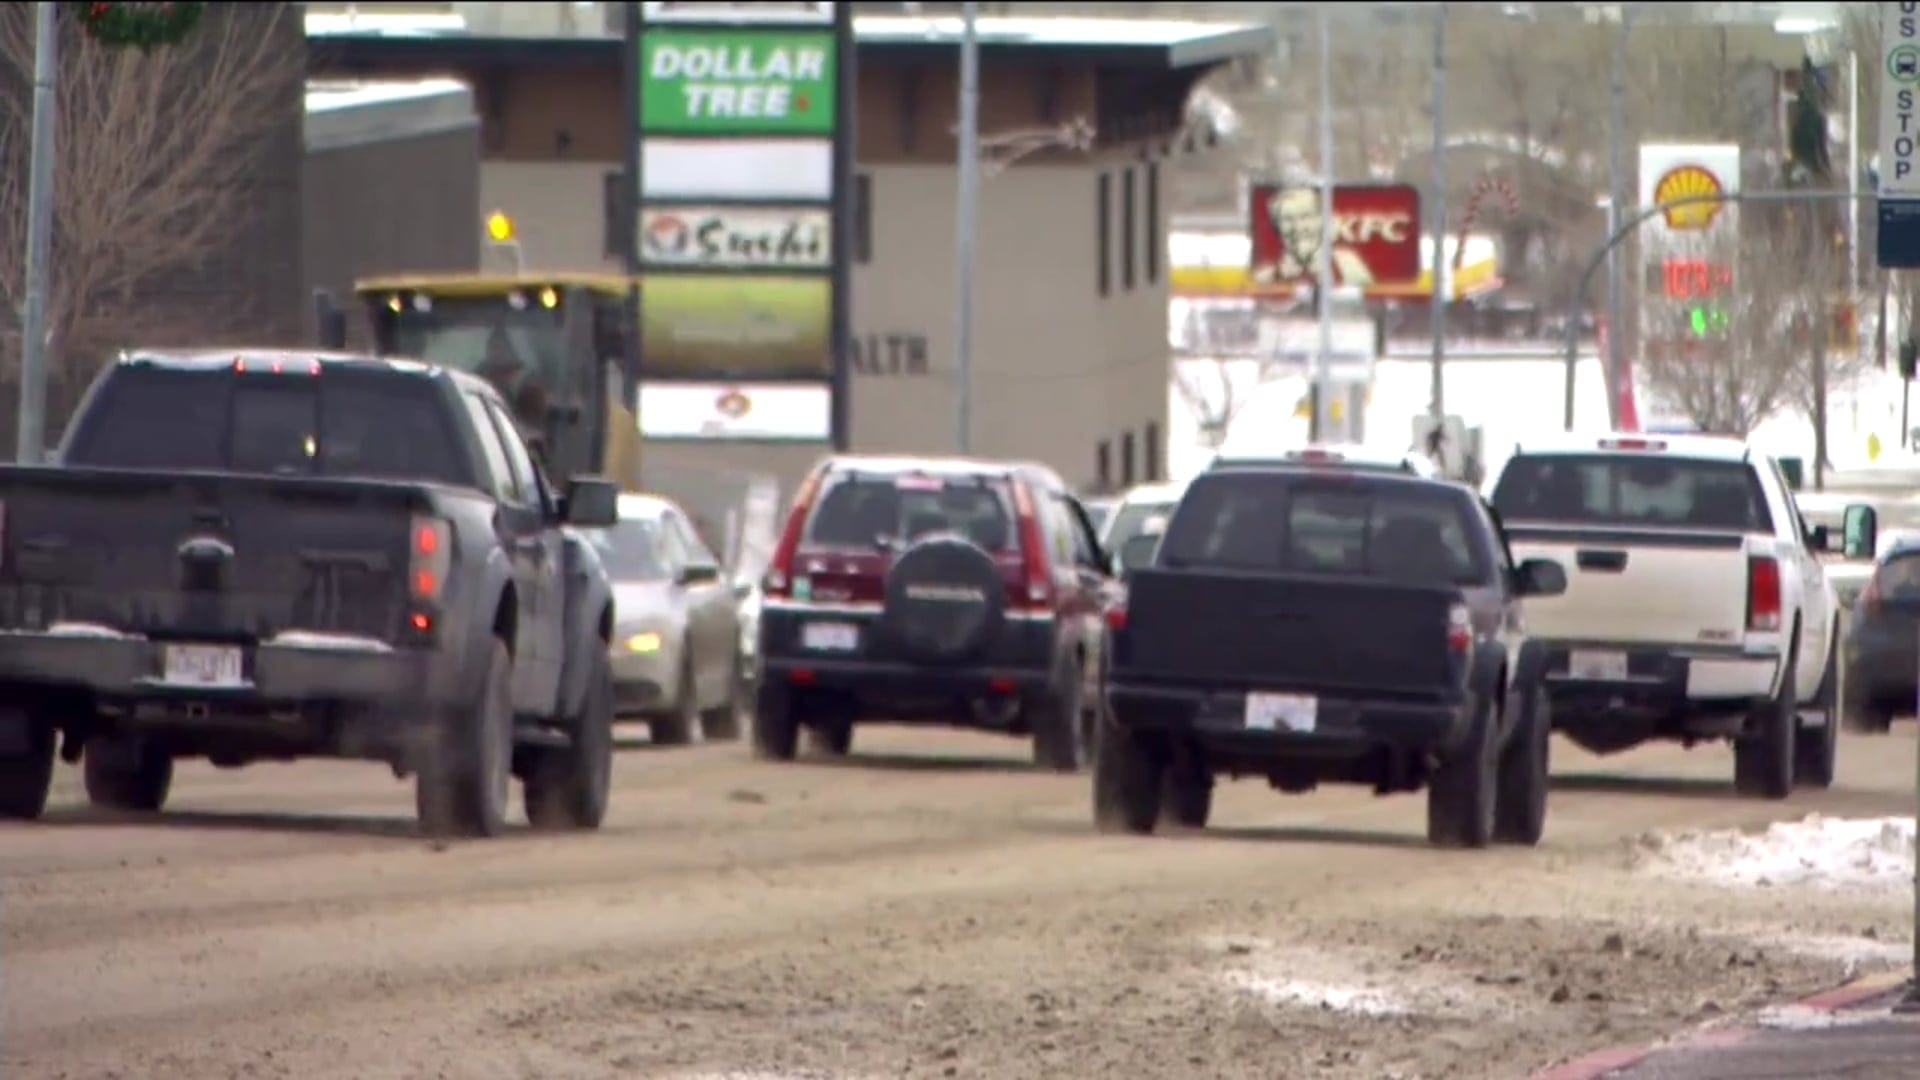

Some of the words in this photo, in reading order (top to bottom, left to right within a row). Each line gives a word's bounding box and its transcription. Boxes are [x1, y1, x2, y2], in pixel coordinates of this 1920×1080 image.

[652, 45, 825, 79] DOLLAR
[684, 86, 790, 118] TREE
[1895, 90, 1914, 179] STOP
[697, 219, 822, 260] Sushi
[1330, 213, 1410, 243] KFC
